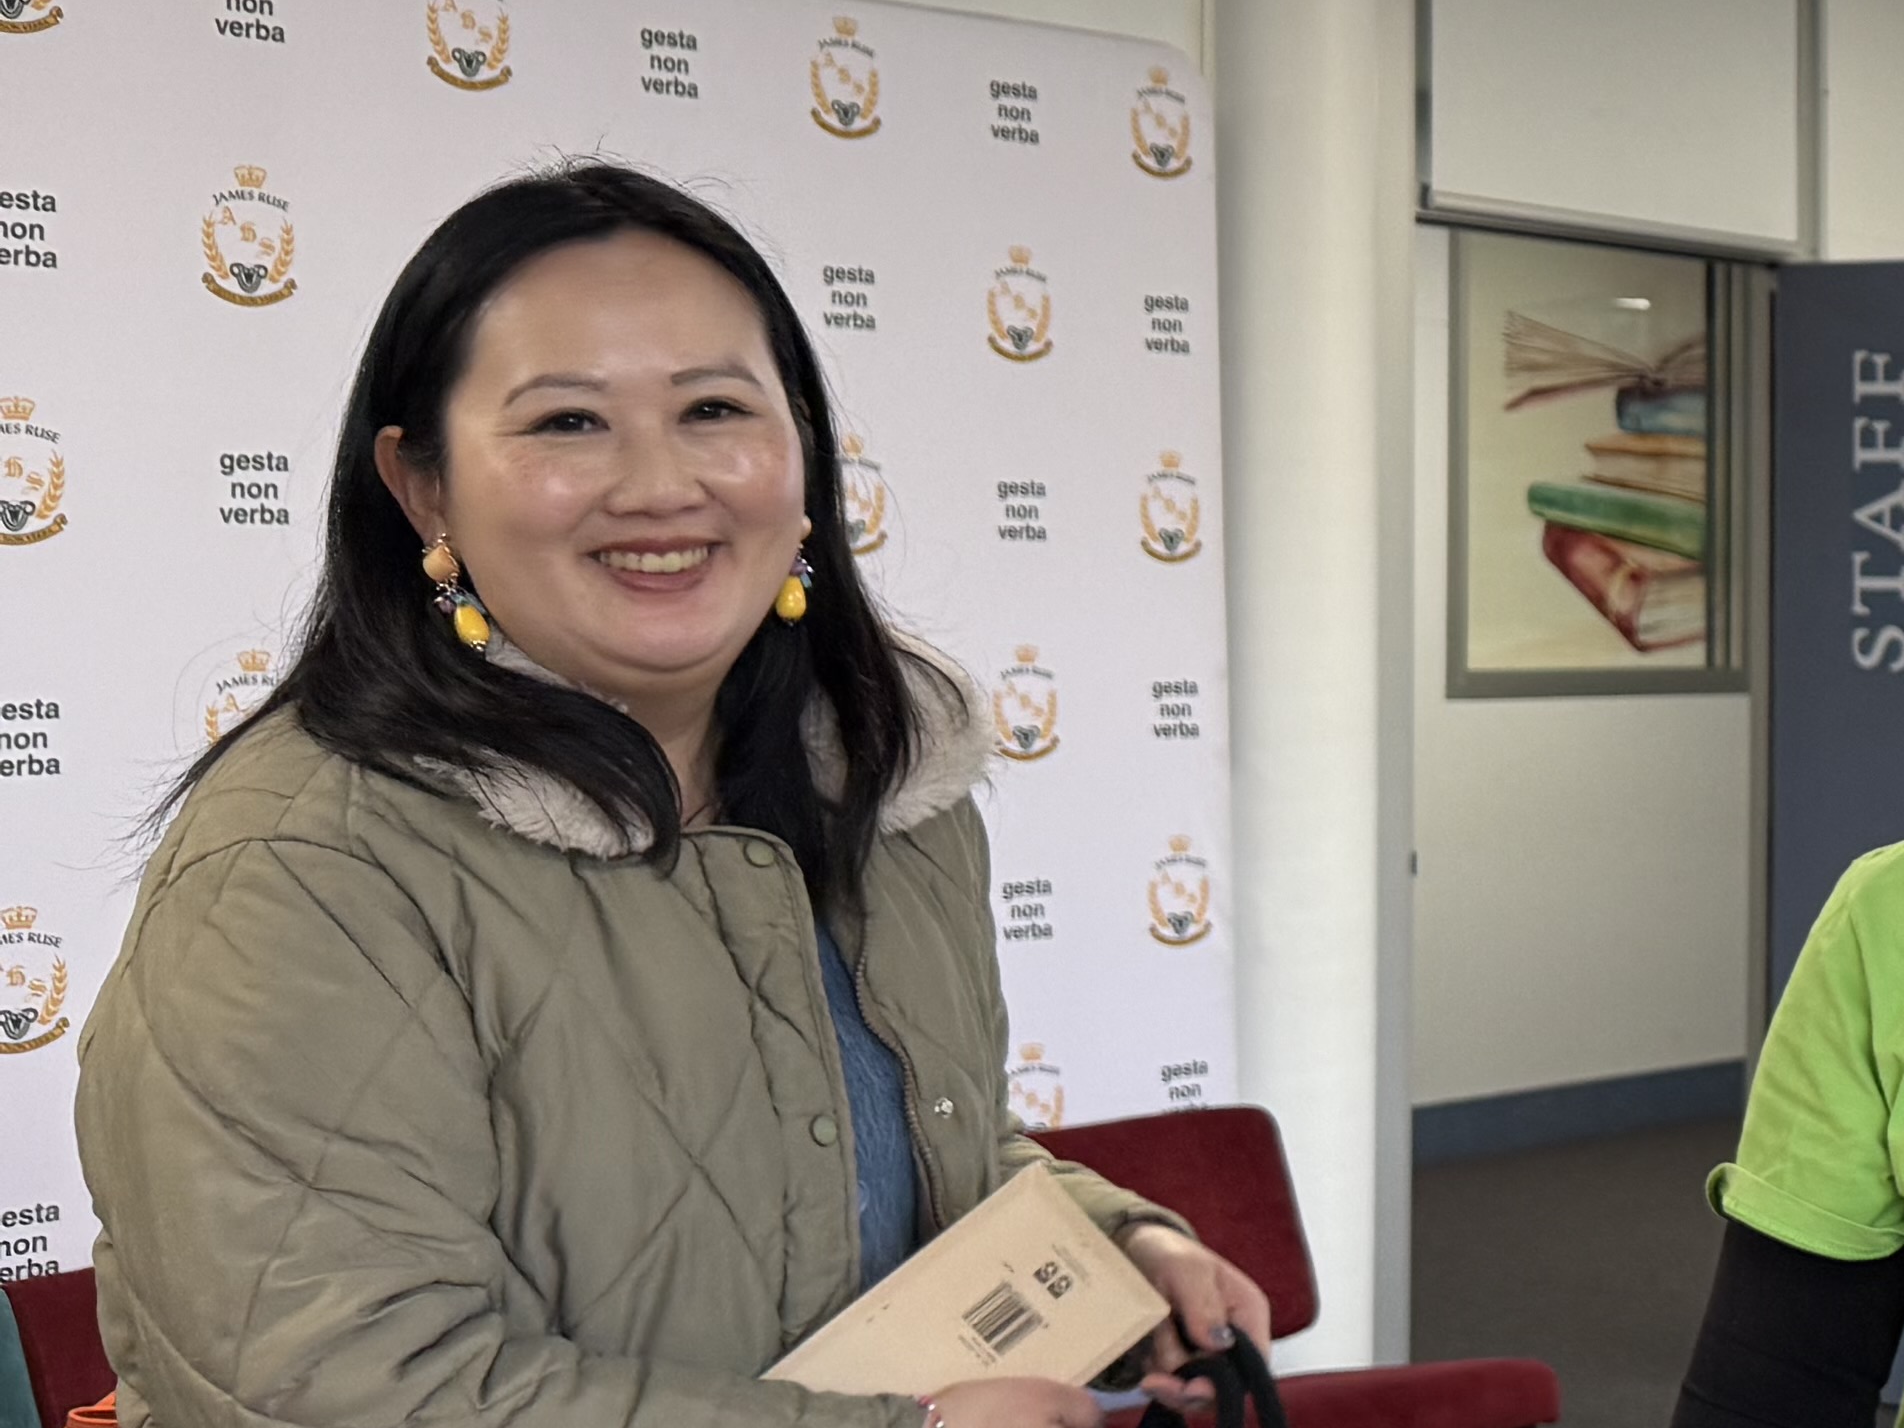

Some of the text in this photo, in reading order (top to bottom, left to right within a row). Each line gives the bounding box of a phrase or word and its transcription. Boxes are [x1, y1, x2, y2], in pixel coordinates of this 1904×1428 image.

[214, 17, 286, 44] verba
[640, 27, 698, 52] gesta
[649, 54, 690, 75] non
[640, 75, 699, 99] verba
[989, 79, 1038, 101] gesta
[997, 103, 1032, 123] non
[990, 124, 1040, 145] verba
[0, 189, 57, 213] esta
[0, 244, 58, 269] erba
[822, 265, 876, 287] gesta
[831, 290, 868, 308] non
[1143, 295, 1189, 314] gesta
[823, 311, 876, 331] verba
[1151, 317, 1183, 333] non
[1144, 336, 1191, 355] verba
[219, 451, 289, 477] gesta
[230, 482, 279, 501] non
[997, 480, 1047, 500] gesta
[219, 502, 290, 526] verba
[1005, 504, 1039, 520] non
[997, 523, 1047, 542] verba
[1151, 678, 1199, 700] gesta
[0, 698, 60, 721] esta
[1159, 703, 1192, 718] non
[1153, 720, 1200, 739] verba
[0, 753, 61, 777] erba
[1002, 879, 1053, 901] gesta
[1010, 903, 1045, 919] non
[1003, 922, 1053, 941] verba
[1160, 1059, 1209, 1084] gesta
[1168, 1083, 1202, 1101] non
[0, 1203, 60, 1228] esta
[0, 1258, 60, 1283] erba
